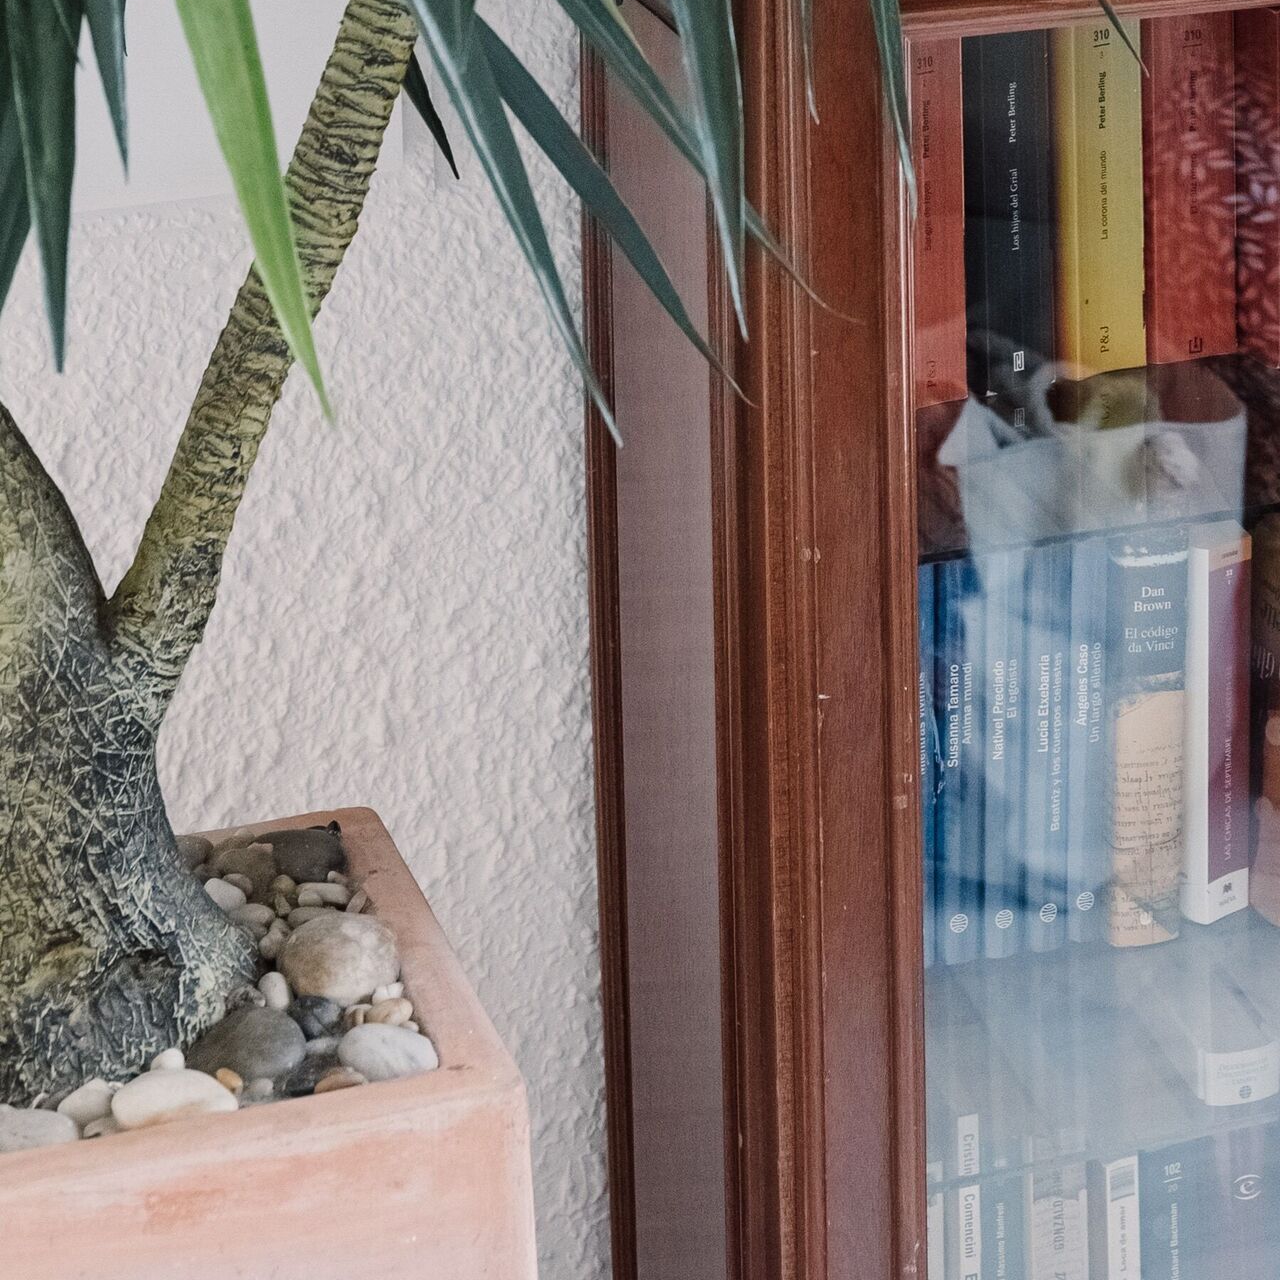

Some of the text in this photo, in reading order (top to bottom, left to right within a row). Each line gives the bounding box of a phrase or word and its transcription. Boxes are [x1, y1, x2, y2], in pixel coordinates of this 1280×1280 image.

[1092, 28, 1110, 42] 310
[1184, 29, 1202, 41] 310
[916, 56, 933, 70] 310
[922, 134, 930, 159] Peter
[1006, 81, 1021, 251] Los hijos del Grial Peter Berling
[1097, 71, 1109, 240] La corona del mundo Peter Berling
[1099, 325, 1110, 354] P&J
[1134, 598, 1171, 612] Brown
[1141, 585, 1165, 598] Dan
[1125, 623, 1178, 641] El código
[1128, 638, 1174, 653] da Vinci
[1052, 652, 1063, 701] celestes
[1074, 644, 1089, 727] Ángeles Caso
[1090, 642, 1102, 743] Un largo silencio
[947, 664, 959, 768] Susanna Tamaro
[962, 662, 973, 745] Anima mundi
[992, 661, 1004, 761] Nativel Preciado
[1006, 706, 1017, 719] El
[1037, 654, 1050, 753] Lucía Etxebarria
[1053, 705, 1064, 753] cuerpos
[1051, 757, 1061, 775] los
[1224, 736, 1232, 789] SEPTIEMBRE
[1050, 788, 1061, 832] Beatriz
[1224, 805, 1232, 842] CHICAS
[1224, 843, 1232, 861] LAS
[963, 1133, 976, 1178] Cristin
[1163, 1161, 1182, 1177] 102
[964, 1193, 977, 1259] Comencini
[1053, 1200, 1065, 1251] GONZALO
[1118, 1233, 1127, 1245] de
[1169, 1202, 1179, 1247] Bachman
